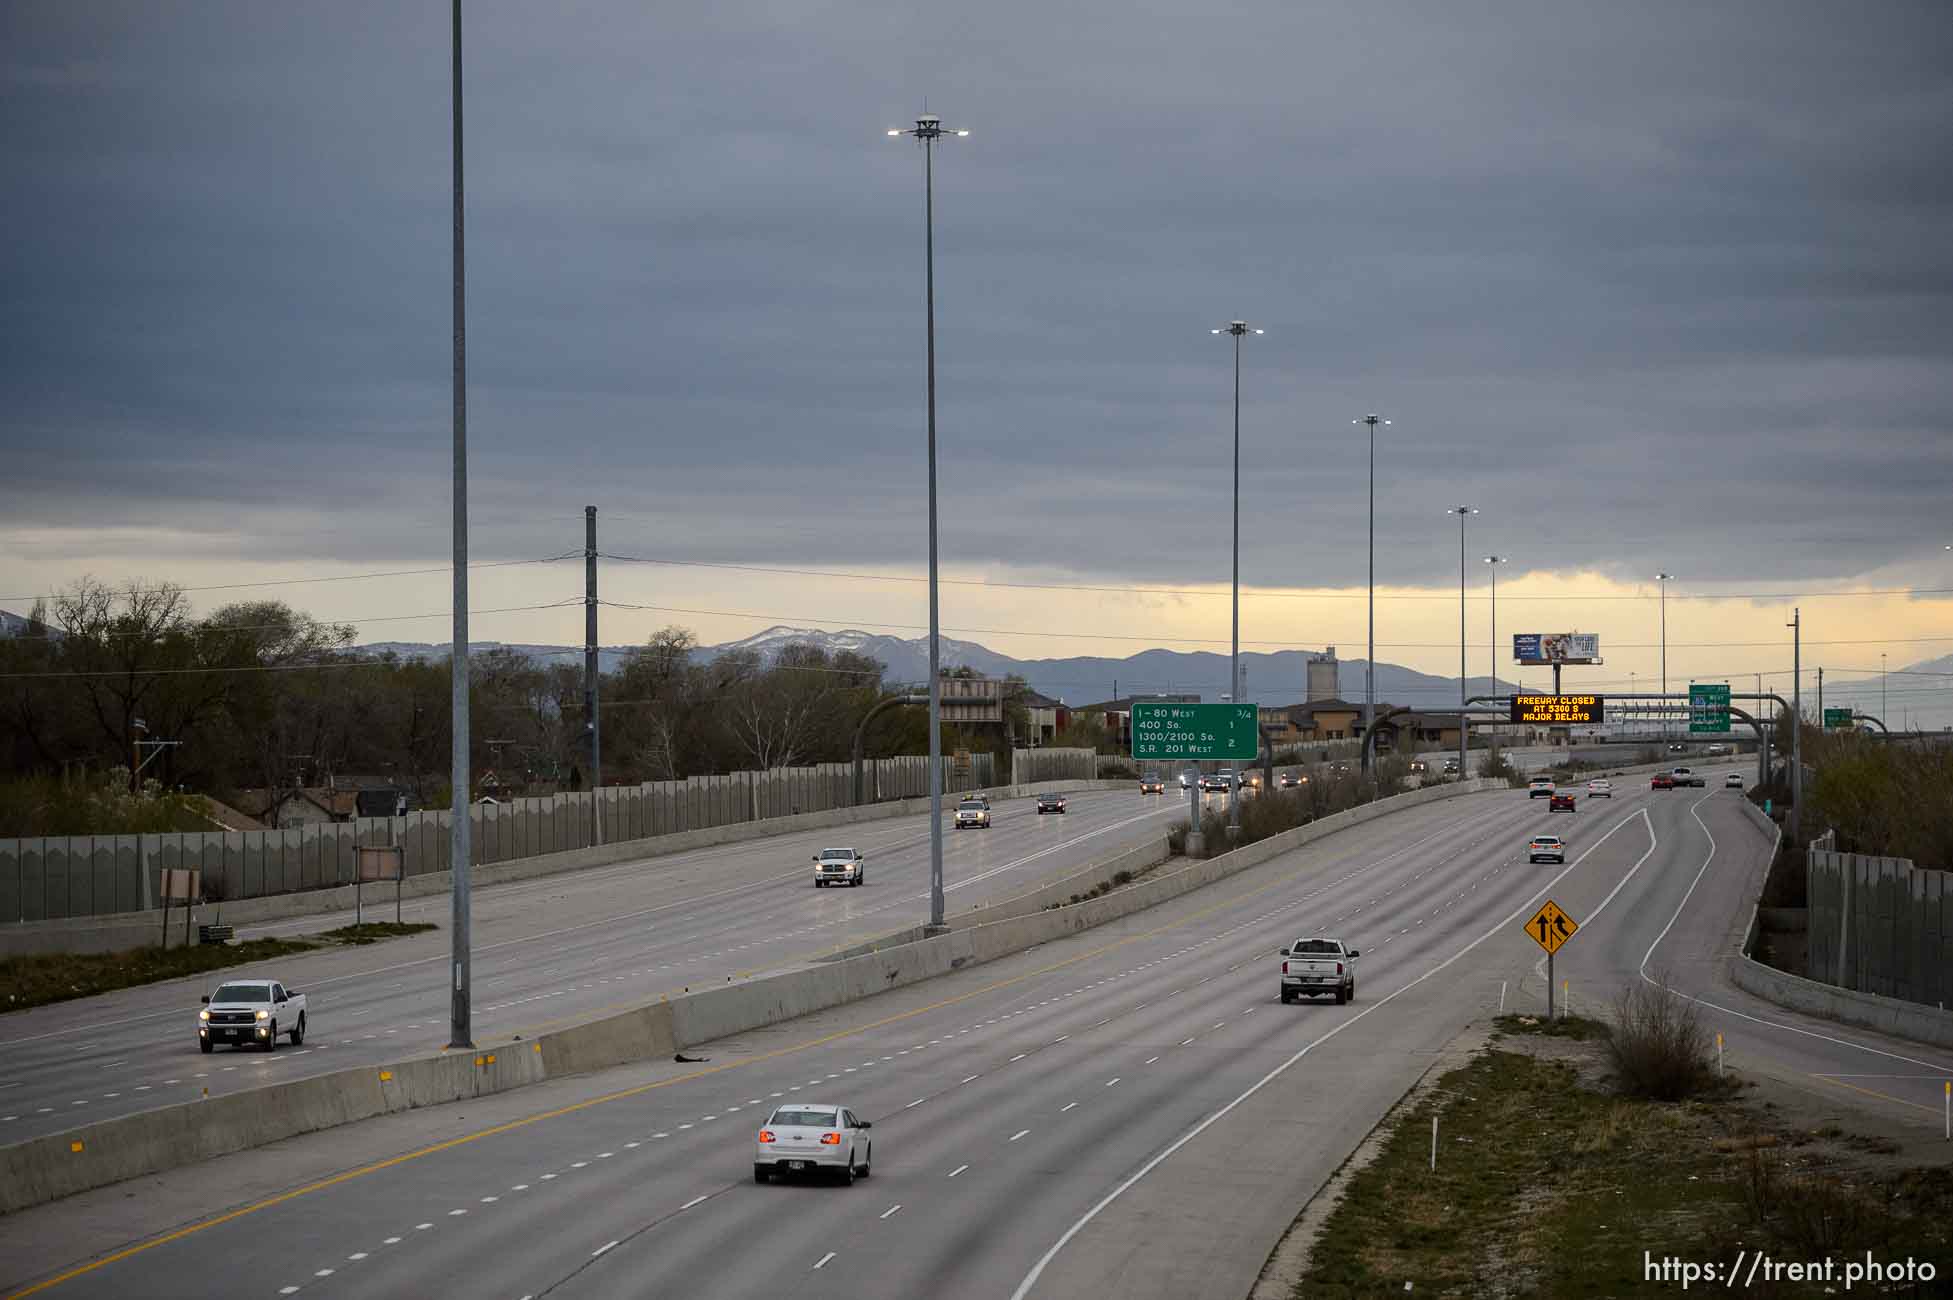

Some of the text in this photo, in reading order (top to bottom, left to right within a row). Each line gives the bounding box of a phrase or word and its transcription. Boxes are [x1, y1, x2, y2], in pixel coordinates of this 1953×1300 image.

[1517, 696, 1595, 705] FREEWAY CLOSED
[1533, 705, 1579, 713] AT 5300 S
[1523, 713, 1590, 721] MAJOR DELAYS
[1139, 721, 1161, 729] 400
[1229, 721, 1235, 729] 1
[1139, 732, 1195, 742] 1300/2100
[1228, 739, 1236, 747] 2
[1139, 745, 1158, 753] S.R.
[1165, 745, 1184, 753] 201
